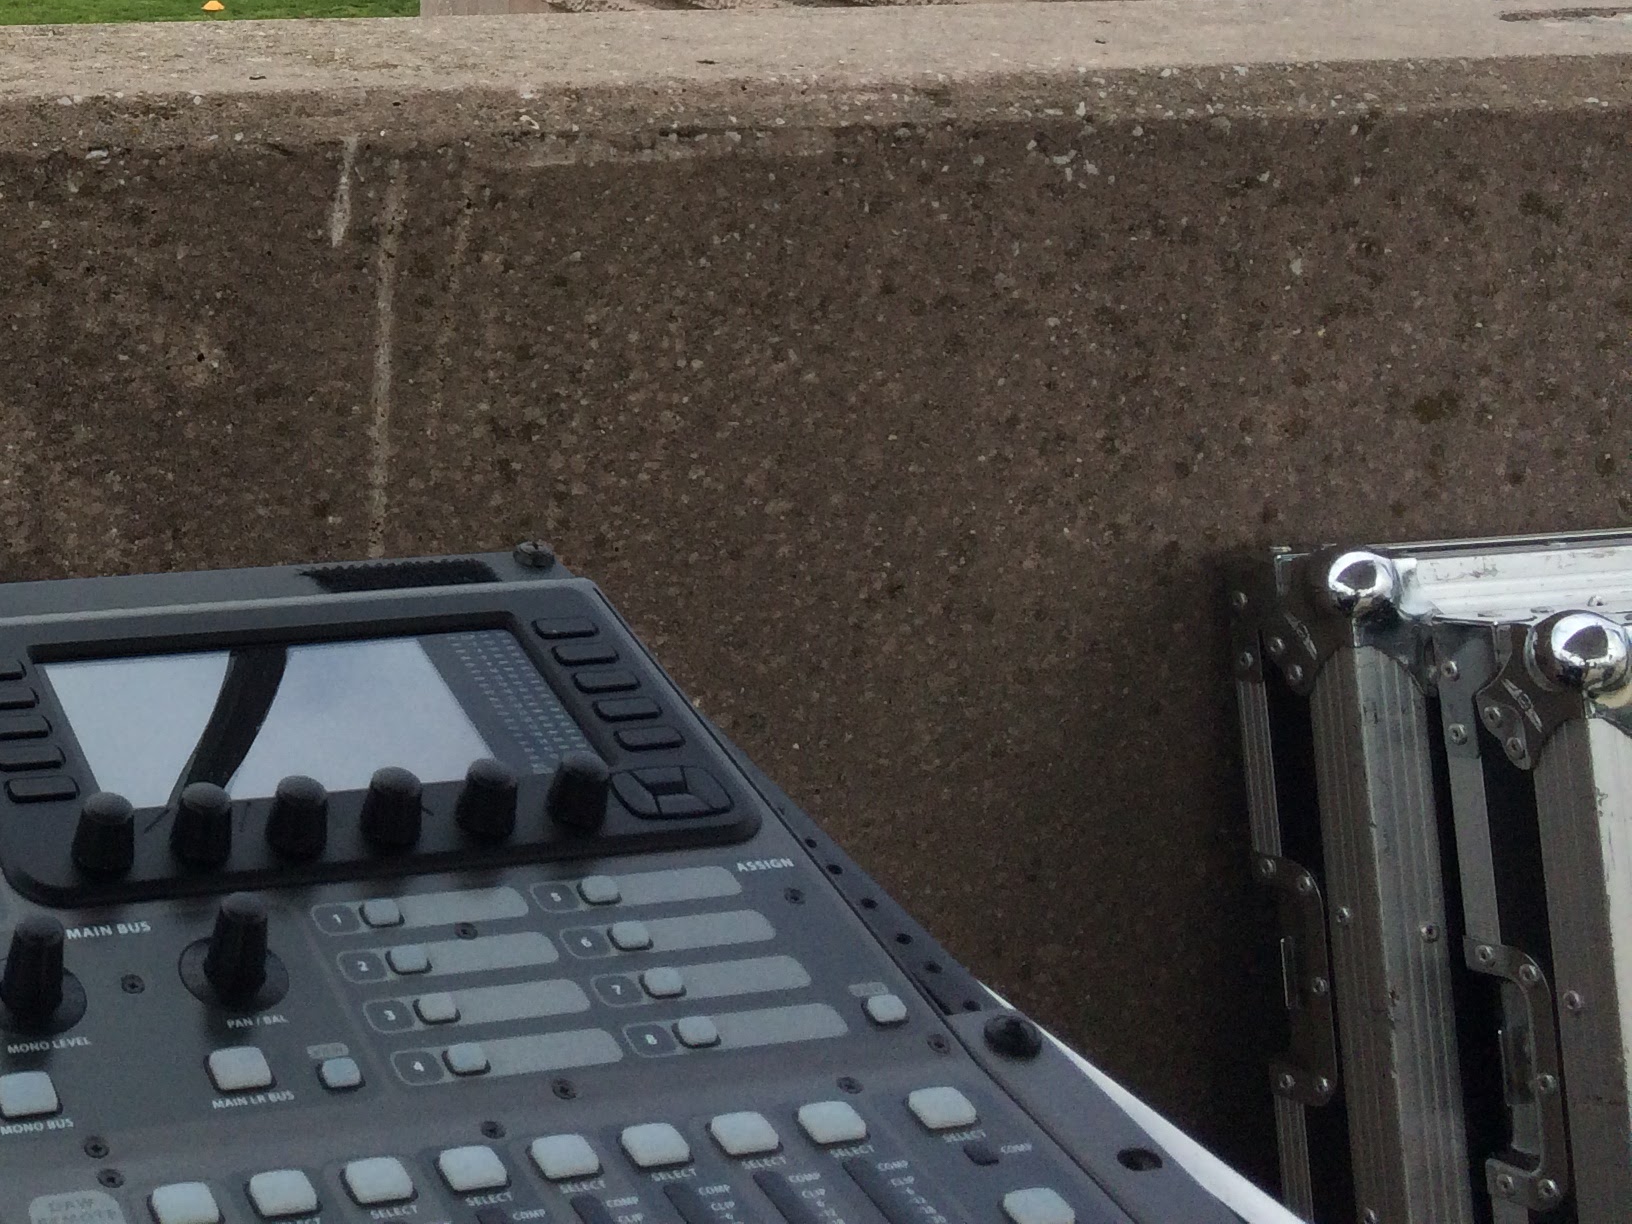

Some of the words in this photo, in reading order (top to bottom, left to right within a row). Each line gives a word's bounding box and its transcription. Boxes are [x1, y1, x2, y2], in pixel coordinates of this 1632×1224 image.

[736, 858, 794, 872] ASSIGN
[333, 913, 342, 924] 1
[66, 925, 113, 940] MAIN
[116, 920, 152, 935] BUS
[226, 1016, 253, 1029] PAN
[7, 1040, 50, 1054] MONO
[51, 1036, 92, 1050] LEVEL
[212, 1096, 248, 1109] MAIN
[249, 1093, 266, 1105] LR
[268, 1090, 295, 1102] BUS
[0, 1122, 44, 1136] MONO
[47, 1117, 74, 1129] BUS
[465, 1191, 513, 1206] SELECT
[370, 1205, 418, 1220] SELECT
[512, 1209, 546, 1221] COMP
